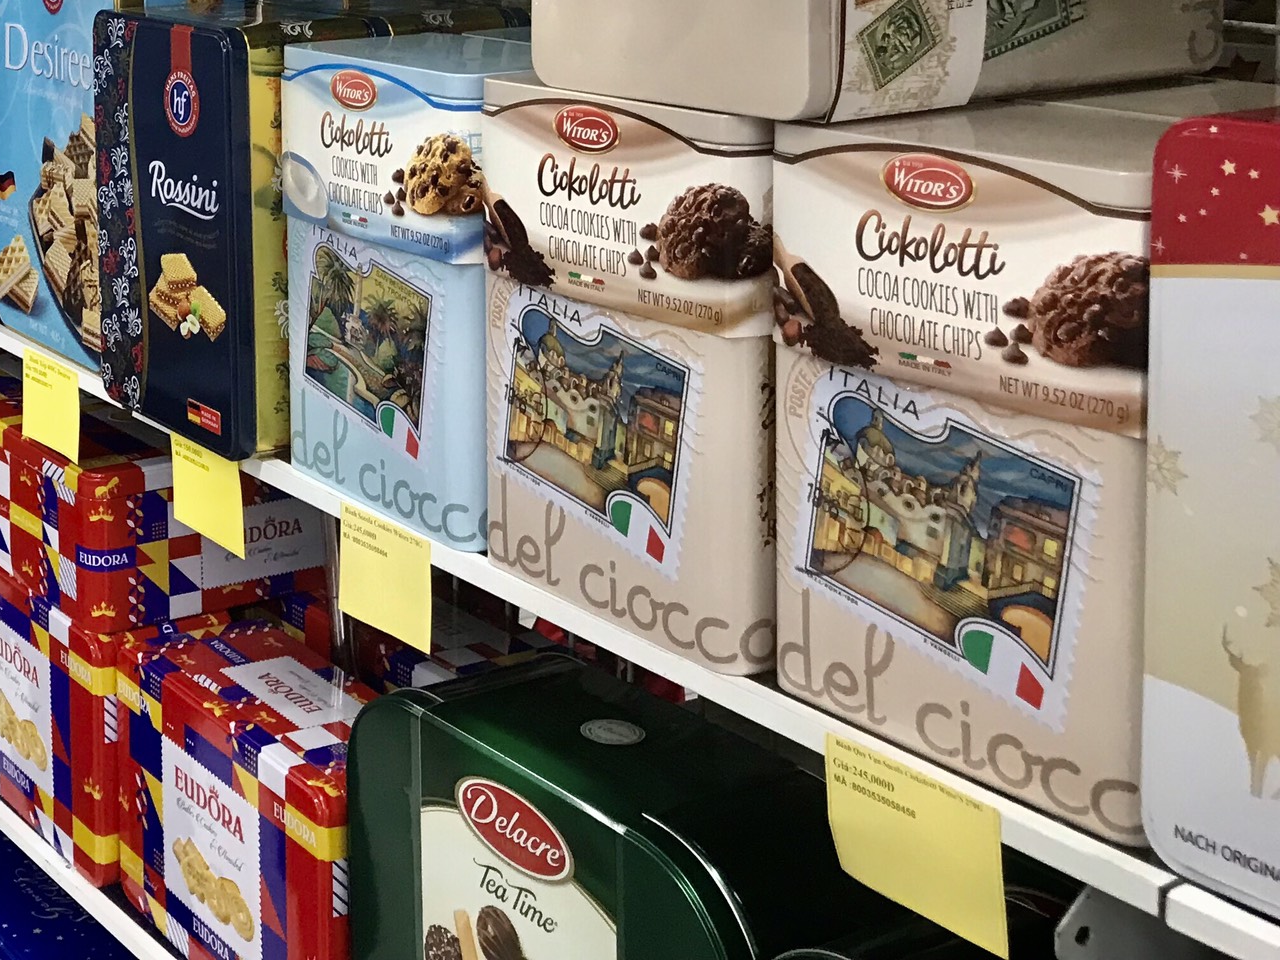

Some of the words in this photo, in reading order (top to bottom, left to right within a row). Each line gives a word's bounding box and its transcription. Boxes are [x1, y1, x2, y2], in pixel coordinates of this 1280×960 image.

[4, 22, 92, 91] Desiree
[164, 71, 181, 92] HANS
[180, 70, 197, 98] FREITAG
[173, 88, 189, 121] hf
[320, 111, 393, 158] Ciokolotti
[562, 111, 609, 141] WITOR'S
[148, 160, 220, 216] Rossini
[331, 155, 360, 180] COOKIES
[361, 162, 378, 186] WITH
[537, 152, 642, 211] Ciokolotti
[893, 162, 960, 199] WITOR'S
[328, 182, 363, 210] CHOCOLATE
[363, 192, 384, 215] CHIPS
[311, 224, 359, 260] ITALIA
[539, 201, 569, 231] COCOA
[570, 208, 610, 241] COOKIES
[612, 217, 637, 248] WITH
[548, 235, 598, 271] CHOCOLATE
[599, 249, 627, 278] CHIPS
[519, 286, 583, 327] ITALIA
[637, 288, 651, 305] NET
[652, 291, 664, 306] WT
[665, 293, 683, 313] 9.52
[684, 297, 694, 315] OZ
[695, 301, 712, 321] (270
[713, 305, 723, 326] g)
[858, 267, 899, 303] COCOA
[902, 276, 959, 317] COOKIES
[962, 290, 999, 325] WITH
[870, 306, 940, 352] CHOCOLATE
[942, 324, 983, 361] CHIPS
[655, 362, 683, 383] CAPRI
[898, 357, 918, 370] MADE
[919, 361, 928, 371] IN
[928, 361, 952, 376] ITALY
[789, 372, 815, 420] POSTE
[828, 366, 920, 420] ITALIA
[999, 375, 1020, 395] NET
[1021, 378, 1039, 398] WT
[1041, 381, 1067, 407] 9.52
[1068, 389, 1085, 410] OZ
[1087, 392, 1113, 419] (270
[1115, 403, 1130, 424] g)
[292, 388, 349, 485] del
[1029, 467, 1069, 492] CAPRI
[488, 474, 566, 586] del
[78, 550, 128, 566] EUDORA
[779, 587, 895, 726] del
[468, 786, 565, 868] Delacre
[1174, 824, 1216, 855] NACH
[473, 857, 508, 903] Tea
[505, 878, 558, 933] Time
